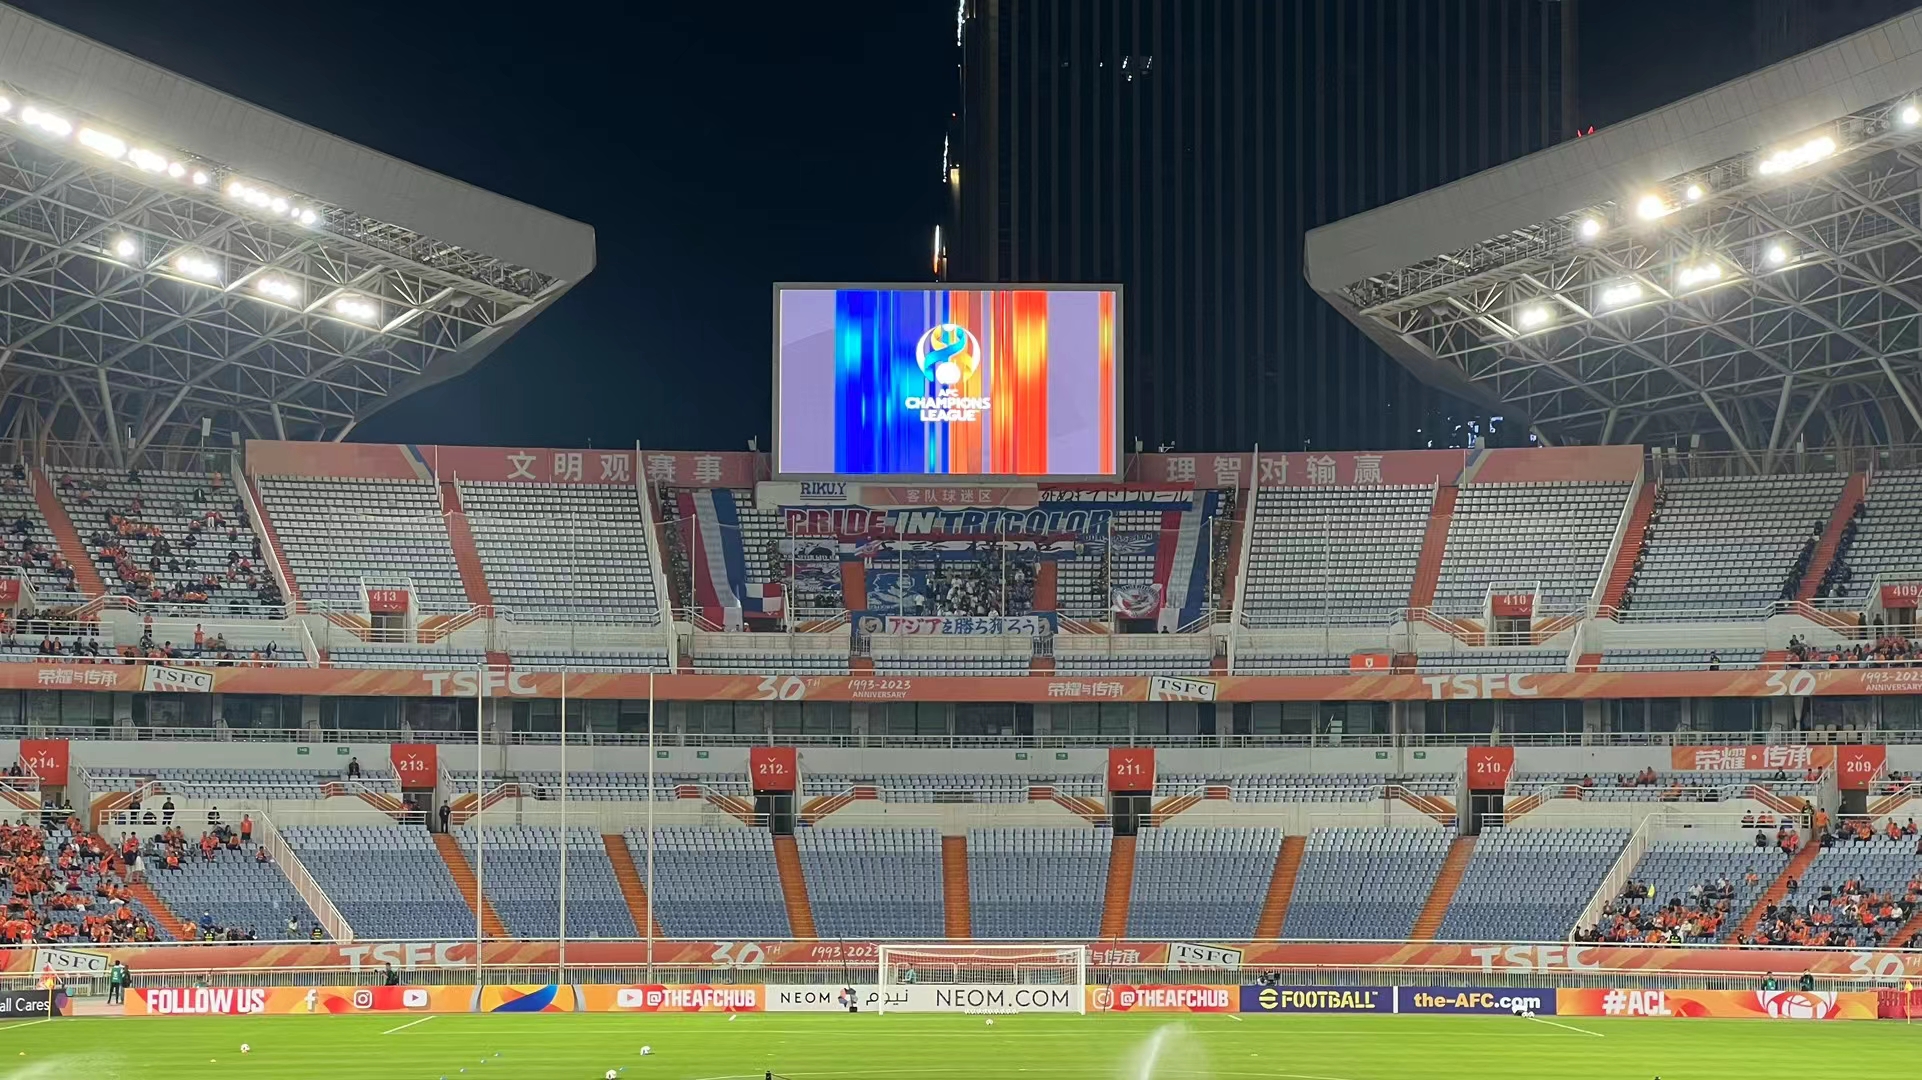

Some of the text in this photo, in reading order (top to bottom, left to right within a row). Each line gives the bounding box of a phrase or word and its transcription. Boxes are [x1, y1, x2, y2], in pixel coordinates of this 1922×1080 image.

[905, 396, 991, 409] CHAMPIONS
[920, 409, 976, 421] LEAGUE
[507, 451, 722, 482] 文明观赛事
[1166, 454, 1383, 484] 理智对输赢
[907, 489, 993, 503] 客队球迷区
[785, 508, 1112, 536] PRIDE IN TRICOLOR
[373, 591, 396, 602] 413
[1504, 595, 1526, 605] 410
[1893, 586, 1918, 596] 409
[38, 669, 118, 685] 荣耀与传承
[153, 668, 206, 687] TSFC
[422, 671, 537, 697] TSFC
[848, 679, 911, 690] 1993-2023
[1422, 673, 1538, 699] TSFC
[1048, 682, 1123, 697] 荣耀与传承
[1158, 679, 1208, 695] TSFC
[340, 942, 467, 972] TSFC
[812, 945, 880, 958] 1993-2023
[1177, 945, 1233, 964] TSFC
[1471, 946, 1600, 974] TSFC
[43, 951, 100, 971] TSFC
[15, 996, 50, 1012] Cares
[147, 989, 265, 1013] FOLLOW US
[646, 989, 756, 1007] @THEAFCHUB
[780, 992, 831, 1004] NEOM
[936, 989, 1069, 1007] NEOM.COM
[1121, 989, 1228, 1008] @THEAFCHUB
[1414, 992, 1540, 1009] the-AFC.com
[1602, 989, 1671, 1016] #ACL
